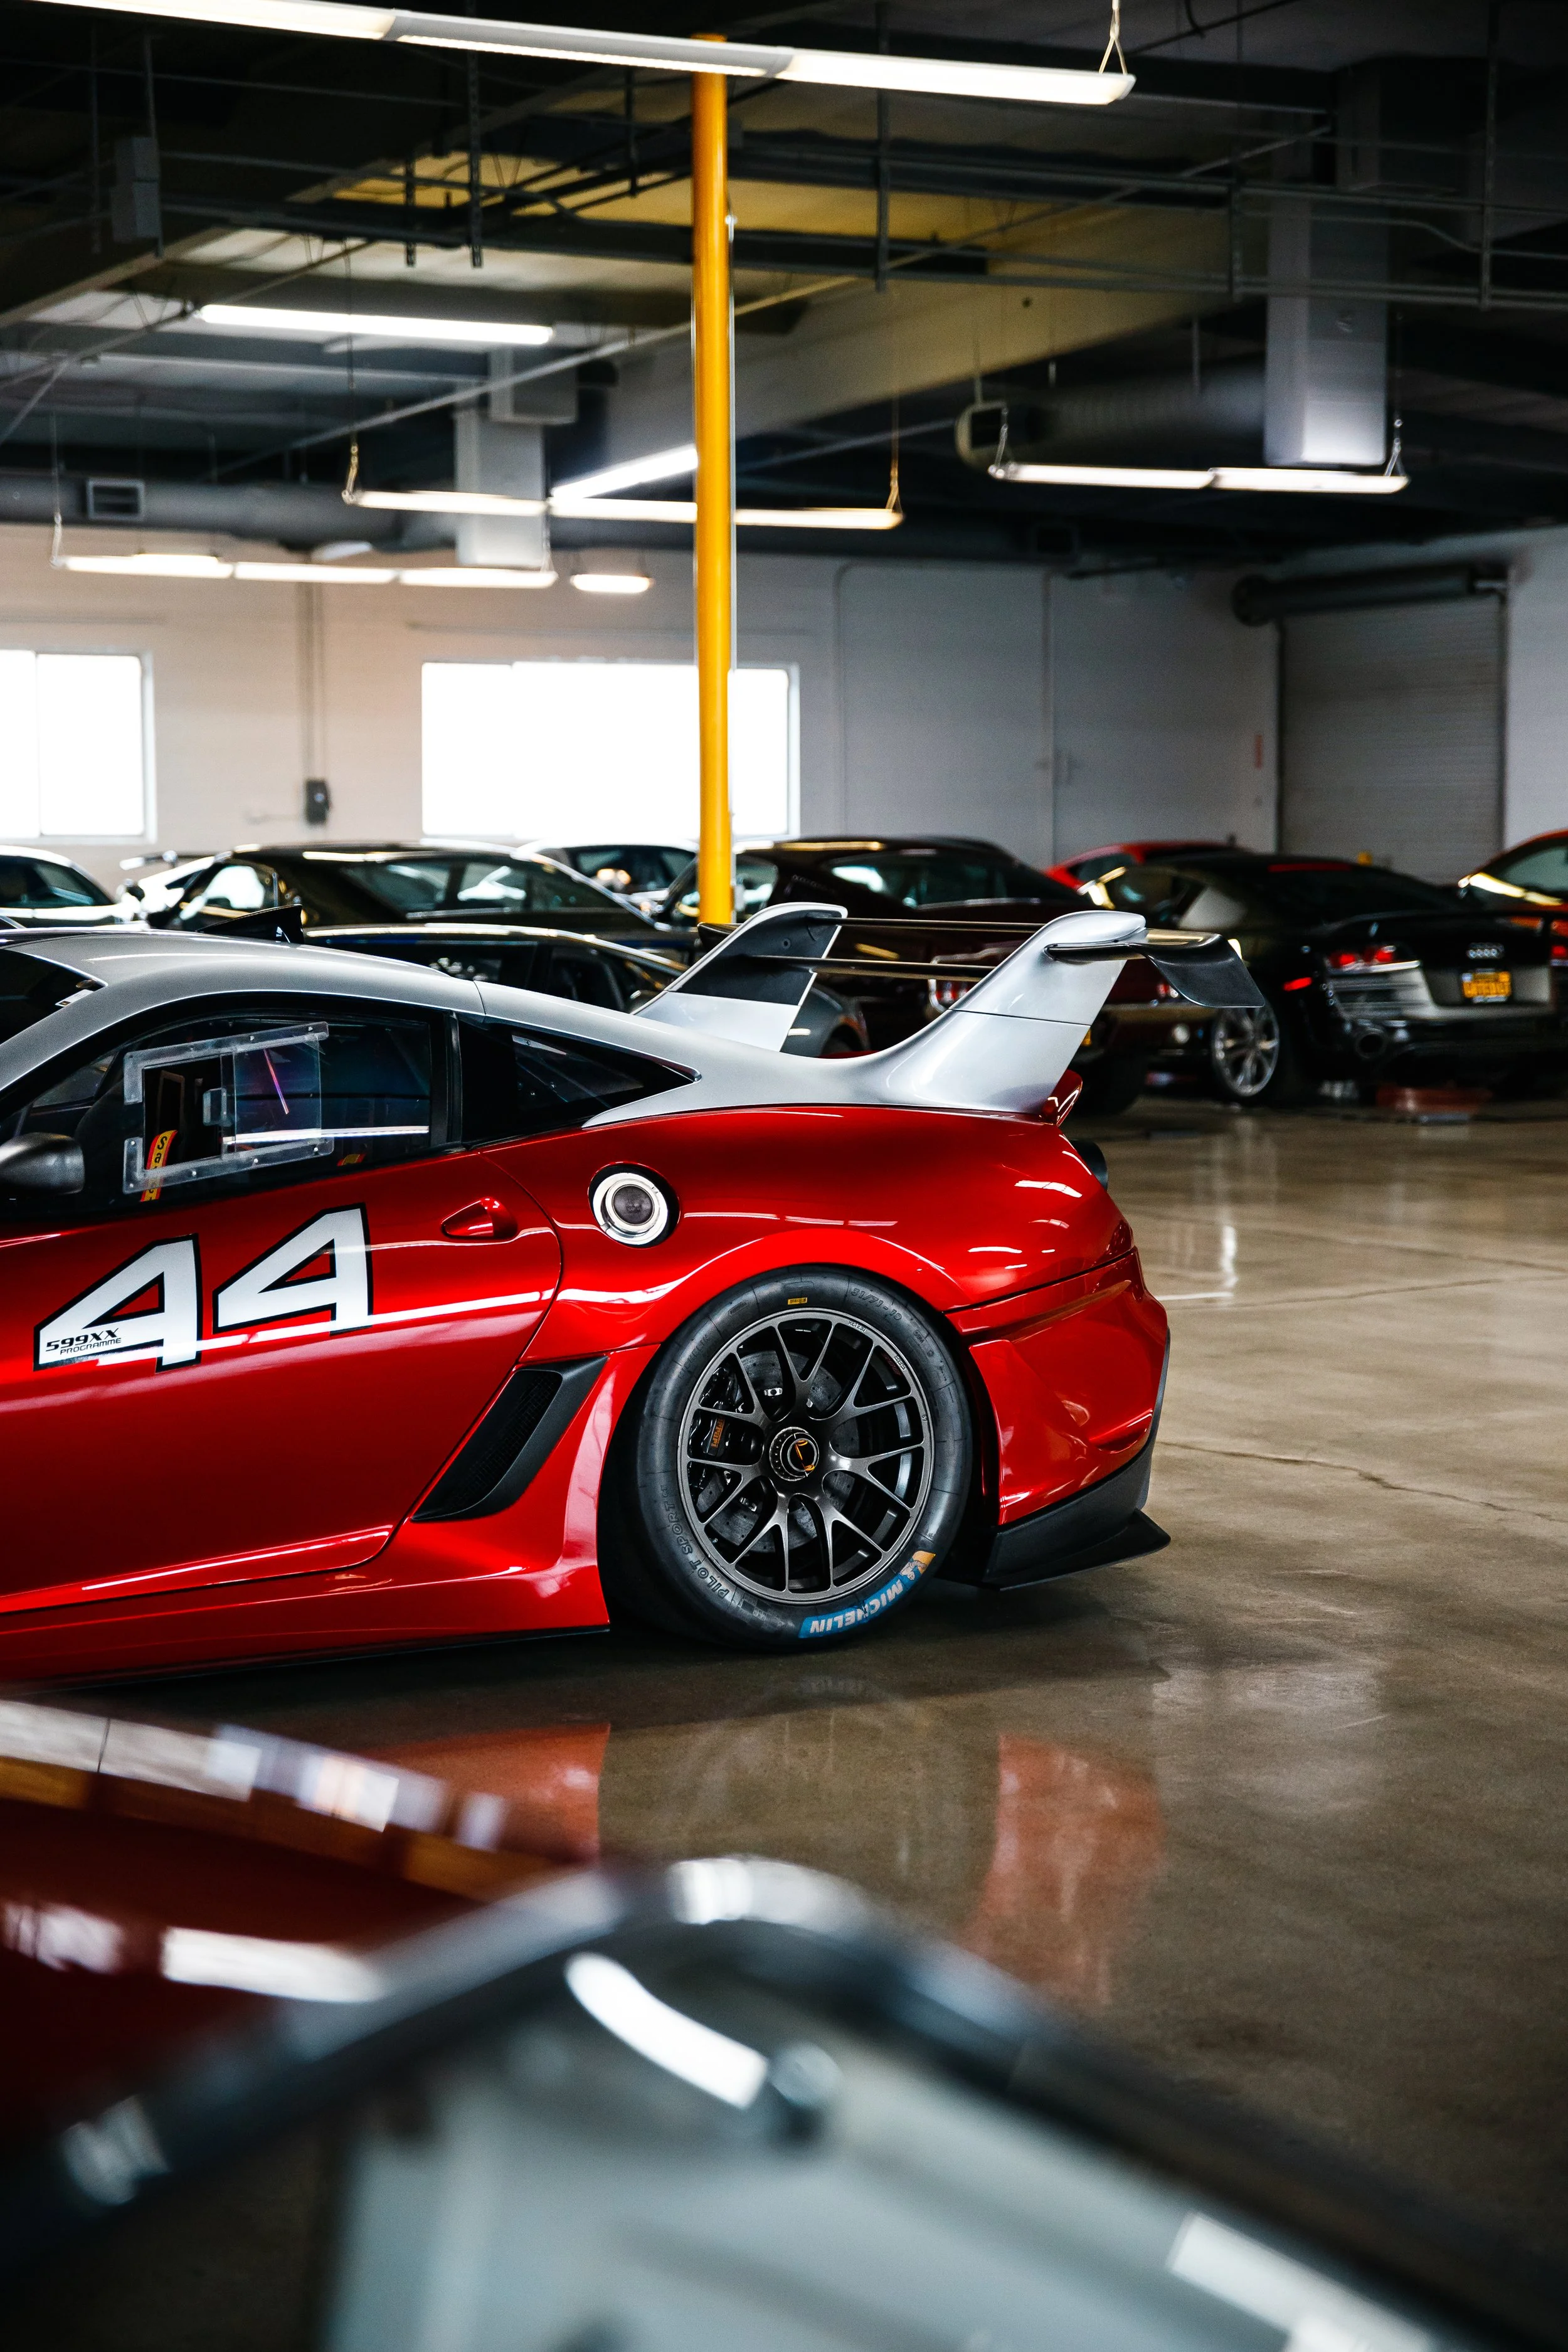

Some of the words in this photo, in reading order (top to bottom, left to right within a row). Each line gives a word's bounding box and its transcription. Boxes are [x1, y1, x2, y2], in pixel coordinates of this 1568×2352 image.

[34, 1202, 373, 1372] 44
[46, 1328, 119, 1352] 599XX
[60, 1338, 121, 1355] PROGRAMME
[894, 1355, 906, 1370] BBS
[665, 1501, 693, 1555] SPORT
[690, 1560, 730, 1599] PILOT
[810, 1579, 903, 1634] MICHELIN
